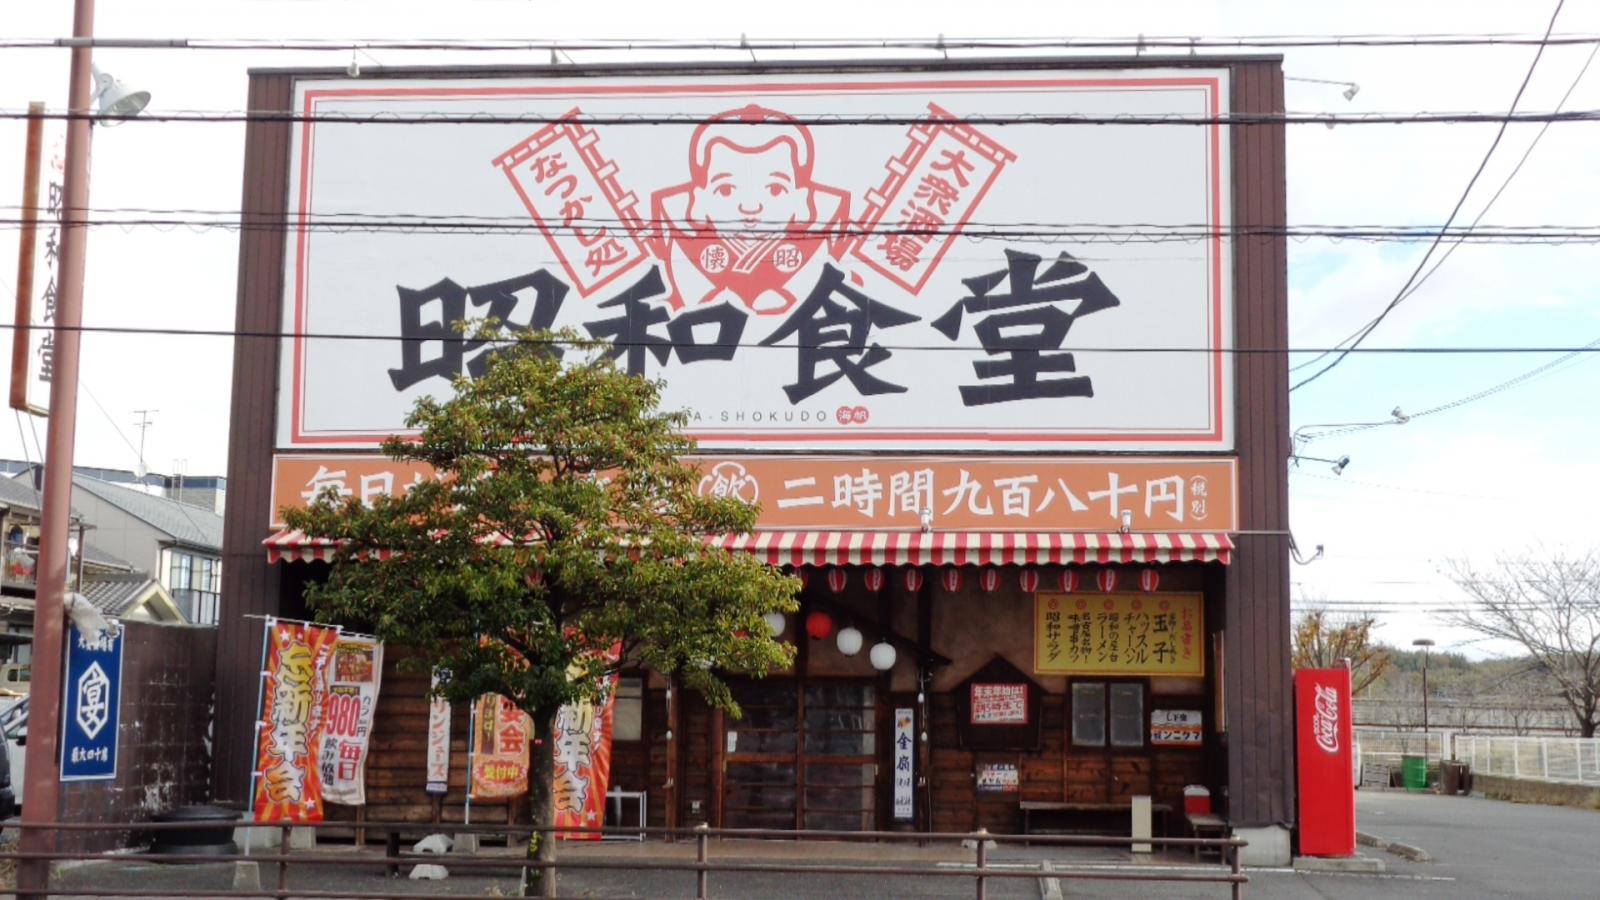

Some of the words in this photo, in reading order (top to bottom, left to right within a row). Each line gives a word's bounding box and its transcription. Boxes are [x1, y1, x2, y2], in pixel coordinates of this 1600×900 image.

[530, 152, 628, 277] なつかし処
[877, 150, 975, 271] 大衆酒場
[702, 247, 725, 270] 懐
[776, 248, 798, 267] 昭
[388, 248, 1120, 407] 昭和食堂
[643, 410, 827, 422] A-SHOKUDO
[712, 473, 746, 505] 飲
[777, 467, 1184, 521] 二時間九百八十円
[1046, 612, 1061, 663] 昭和サラダ
[1096, 612, 1108, 663] ラーメン
[1108, 612, 1120, 663] 昭和の屋台
[1124, 613, 1136, 665] チャーハン
[1136, 612, 1150, 664] ハッスル
[1152, 614, 1169, 664] 玉子
[80, 666, 107, 725] 宴
[1315, 683, 1339, 752] Coca-Cola
[338, 741, 361, 781] 毎日
